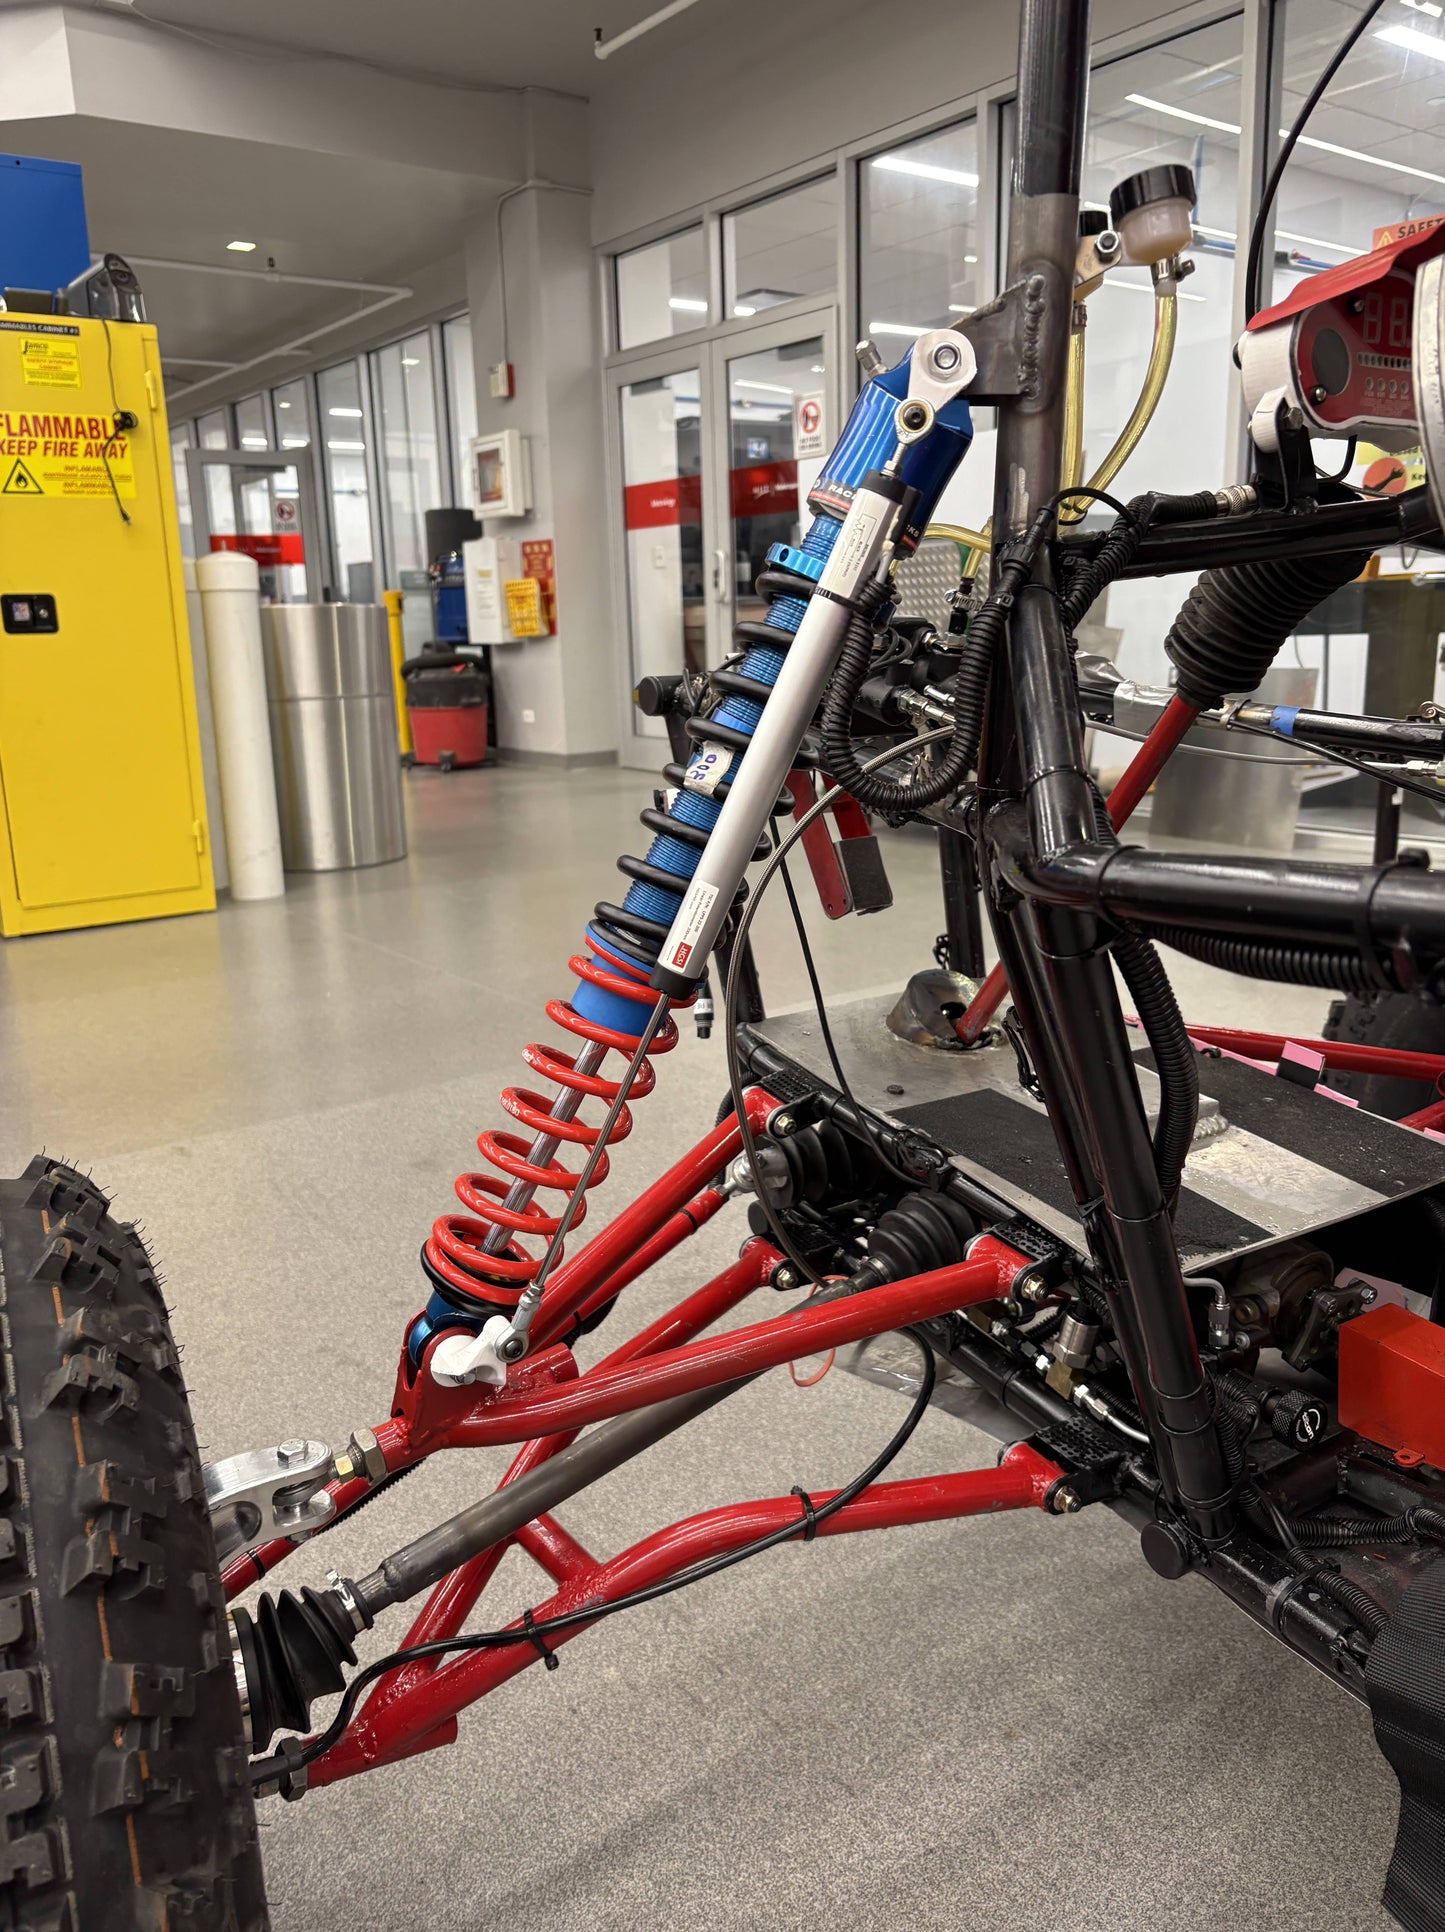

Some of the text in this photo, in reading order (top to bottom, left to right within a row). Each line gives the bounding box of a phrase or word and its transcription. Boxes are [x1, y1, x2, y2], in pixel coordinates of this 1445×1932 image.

[0, 413, 126, 441] LAMMABLE
[43, 441, 78, 458] FIRE
[84, 442, 128, 459] AWAY
